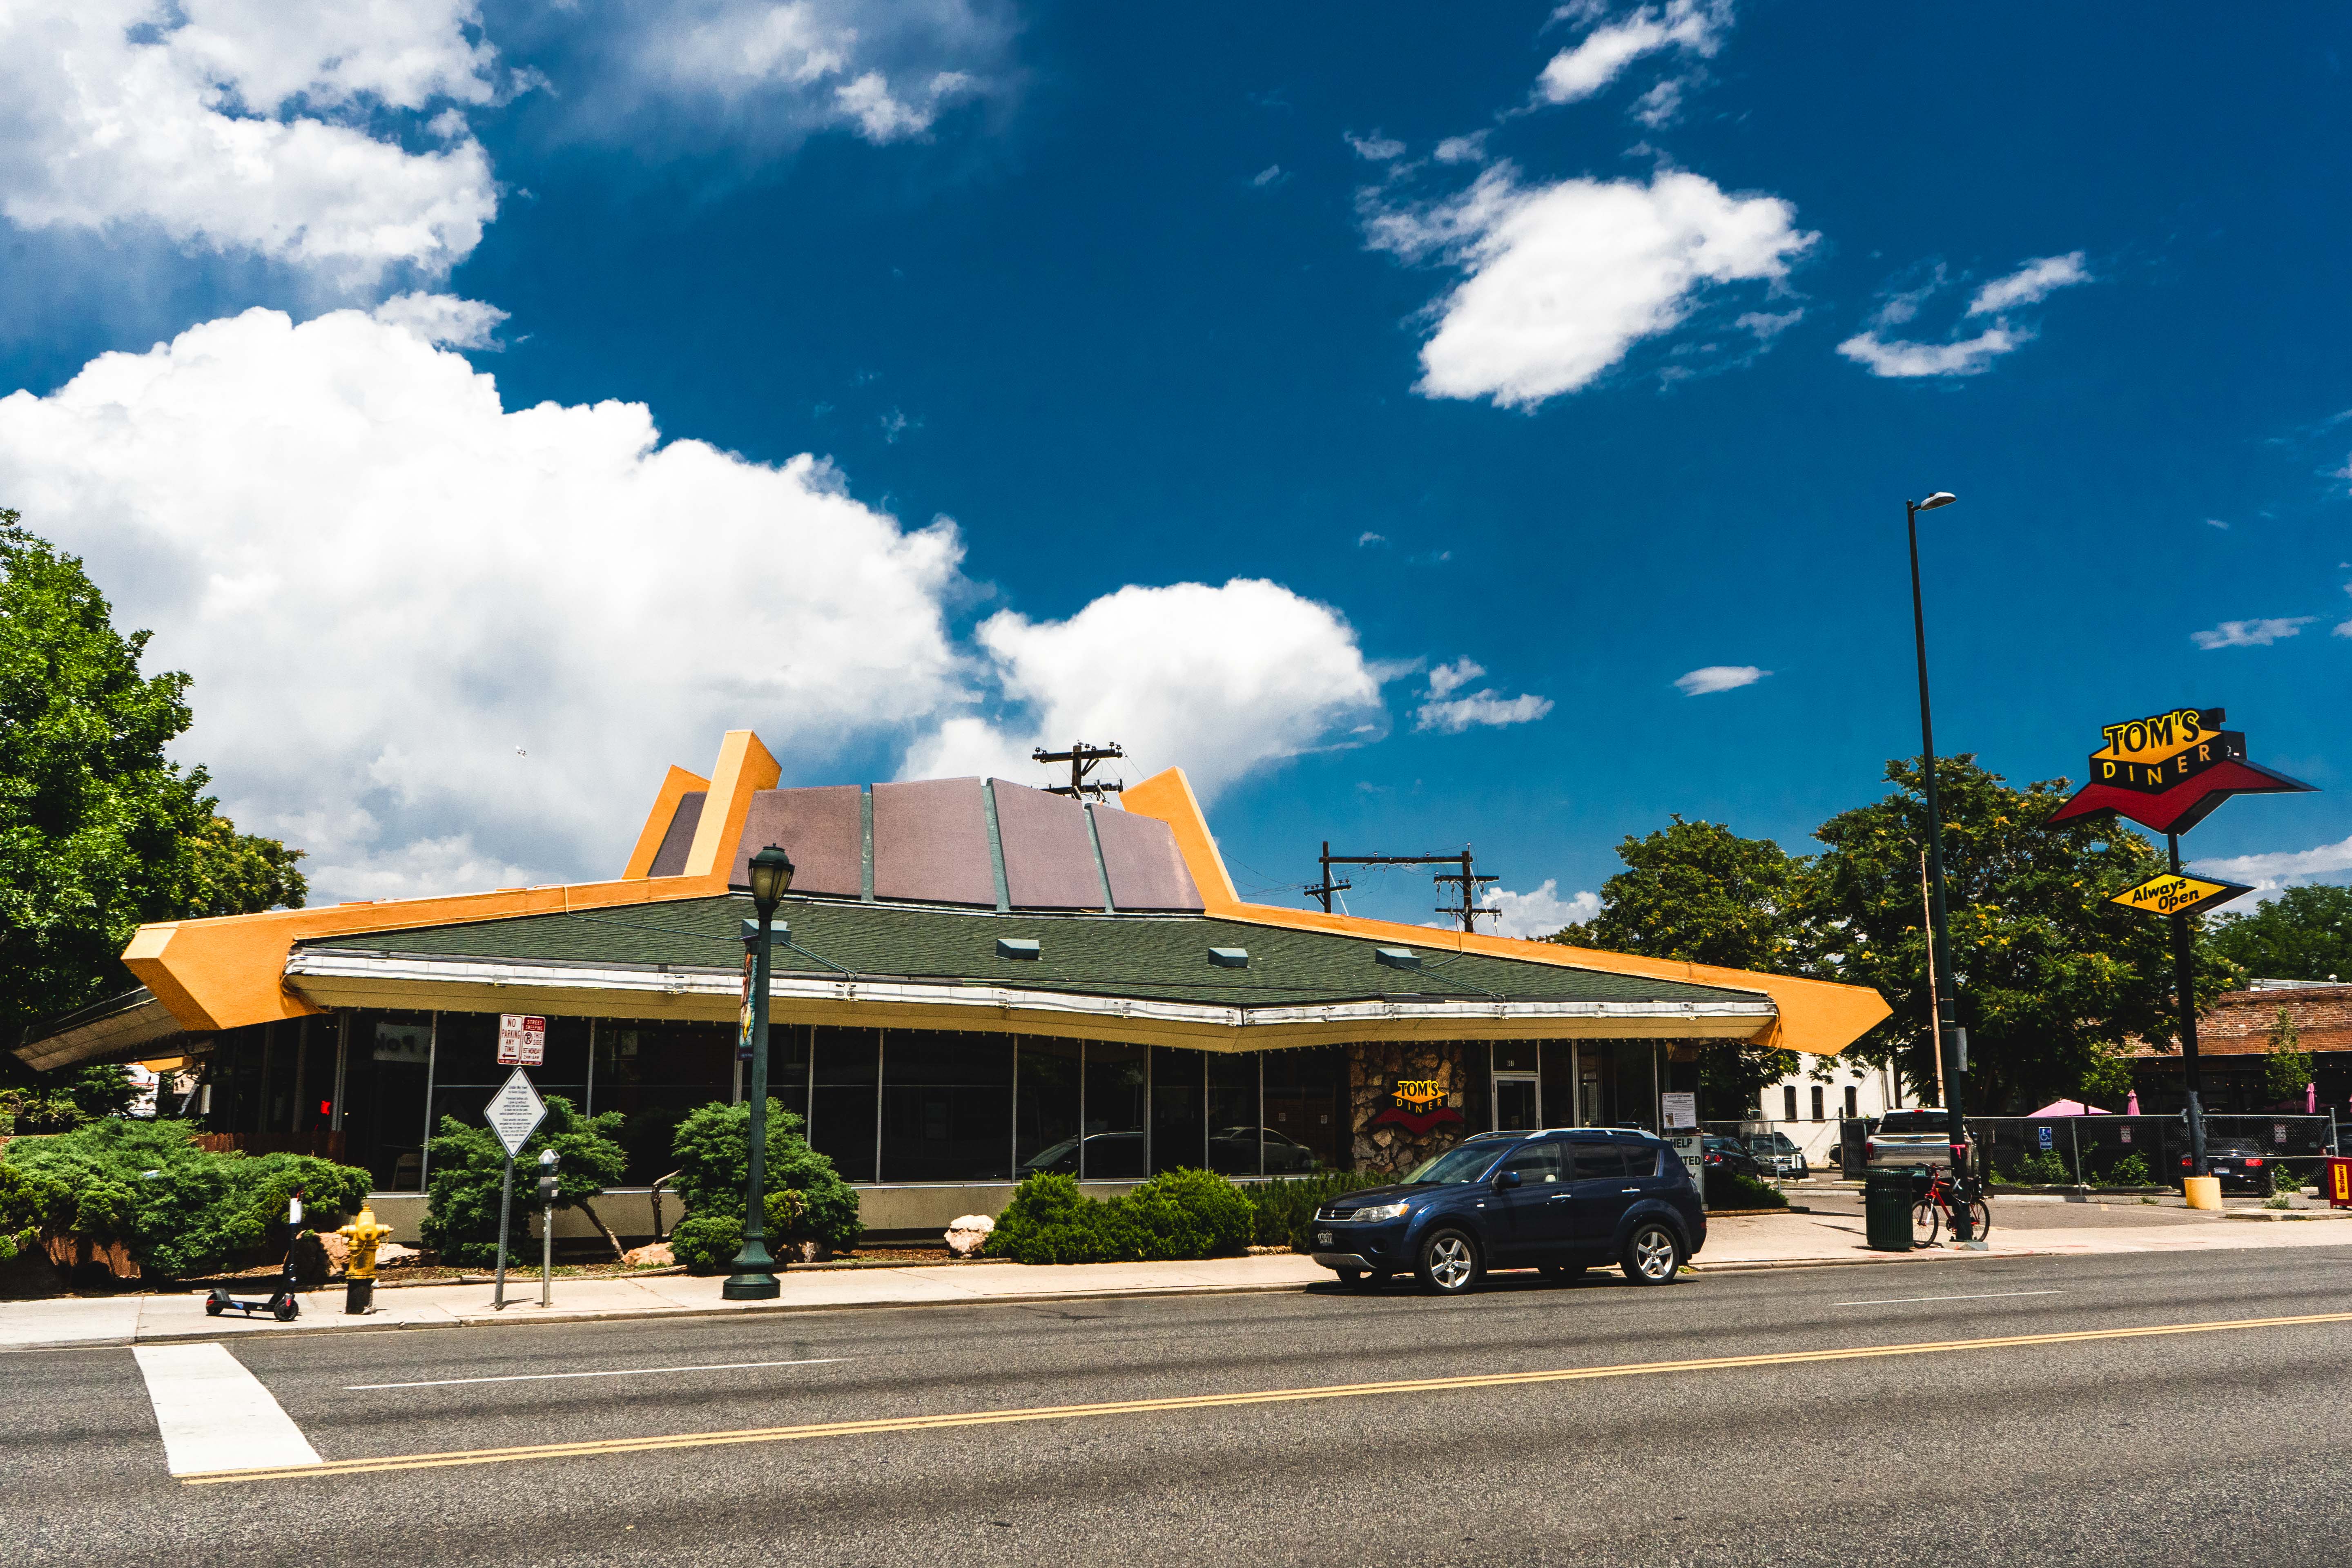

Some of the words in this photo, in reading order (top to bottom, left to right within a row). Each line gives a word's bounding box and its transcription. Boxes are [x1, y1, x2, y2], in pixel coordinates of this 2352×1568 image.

[2105, 712, 2200, 756] TOM'S
[2103, 745, 2211, 785] DINER
[2132, 879, 2187, 904] Always
[2158, 890, 2200, 912] Open
[507, 1018, 516, 1027] NO
[502, 1029, 520, 1039] PARKING
[1399, 1082, 1438, 1097] TOM'S
[1397, 1098, 1442, 1113] DINER
[1670, 1138, 1692, 1148] HELP
[1680, 1156, 1701, 1166] TED
[2337, 1166, 2346, 1193] Westword
